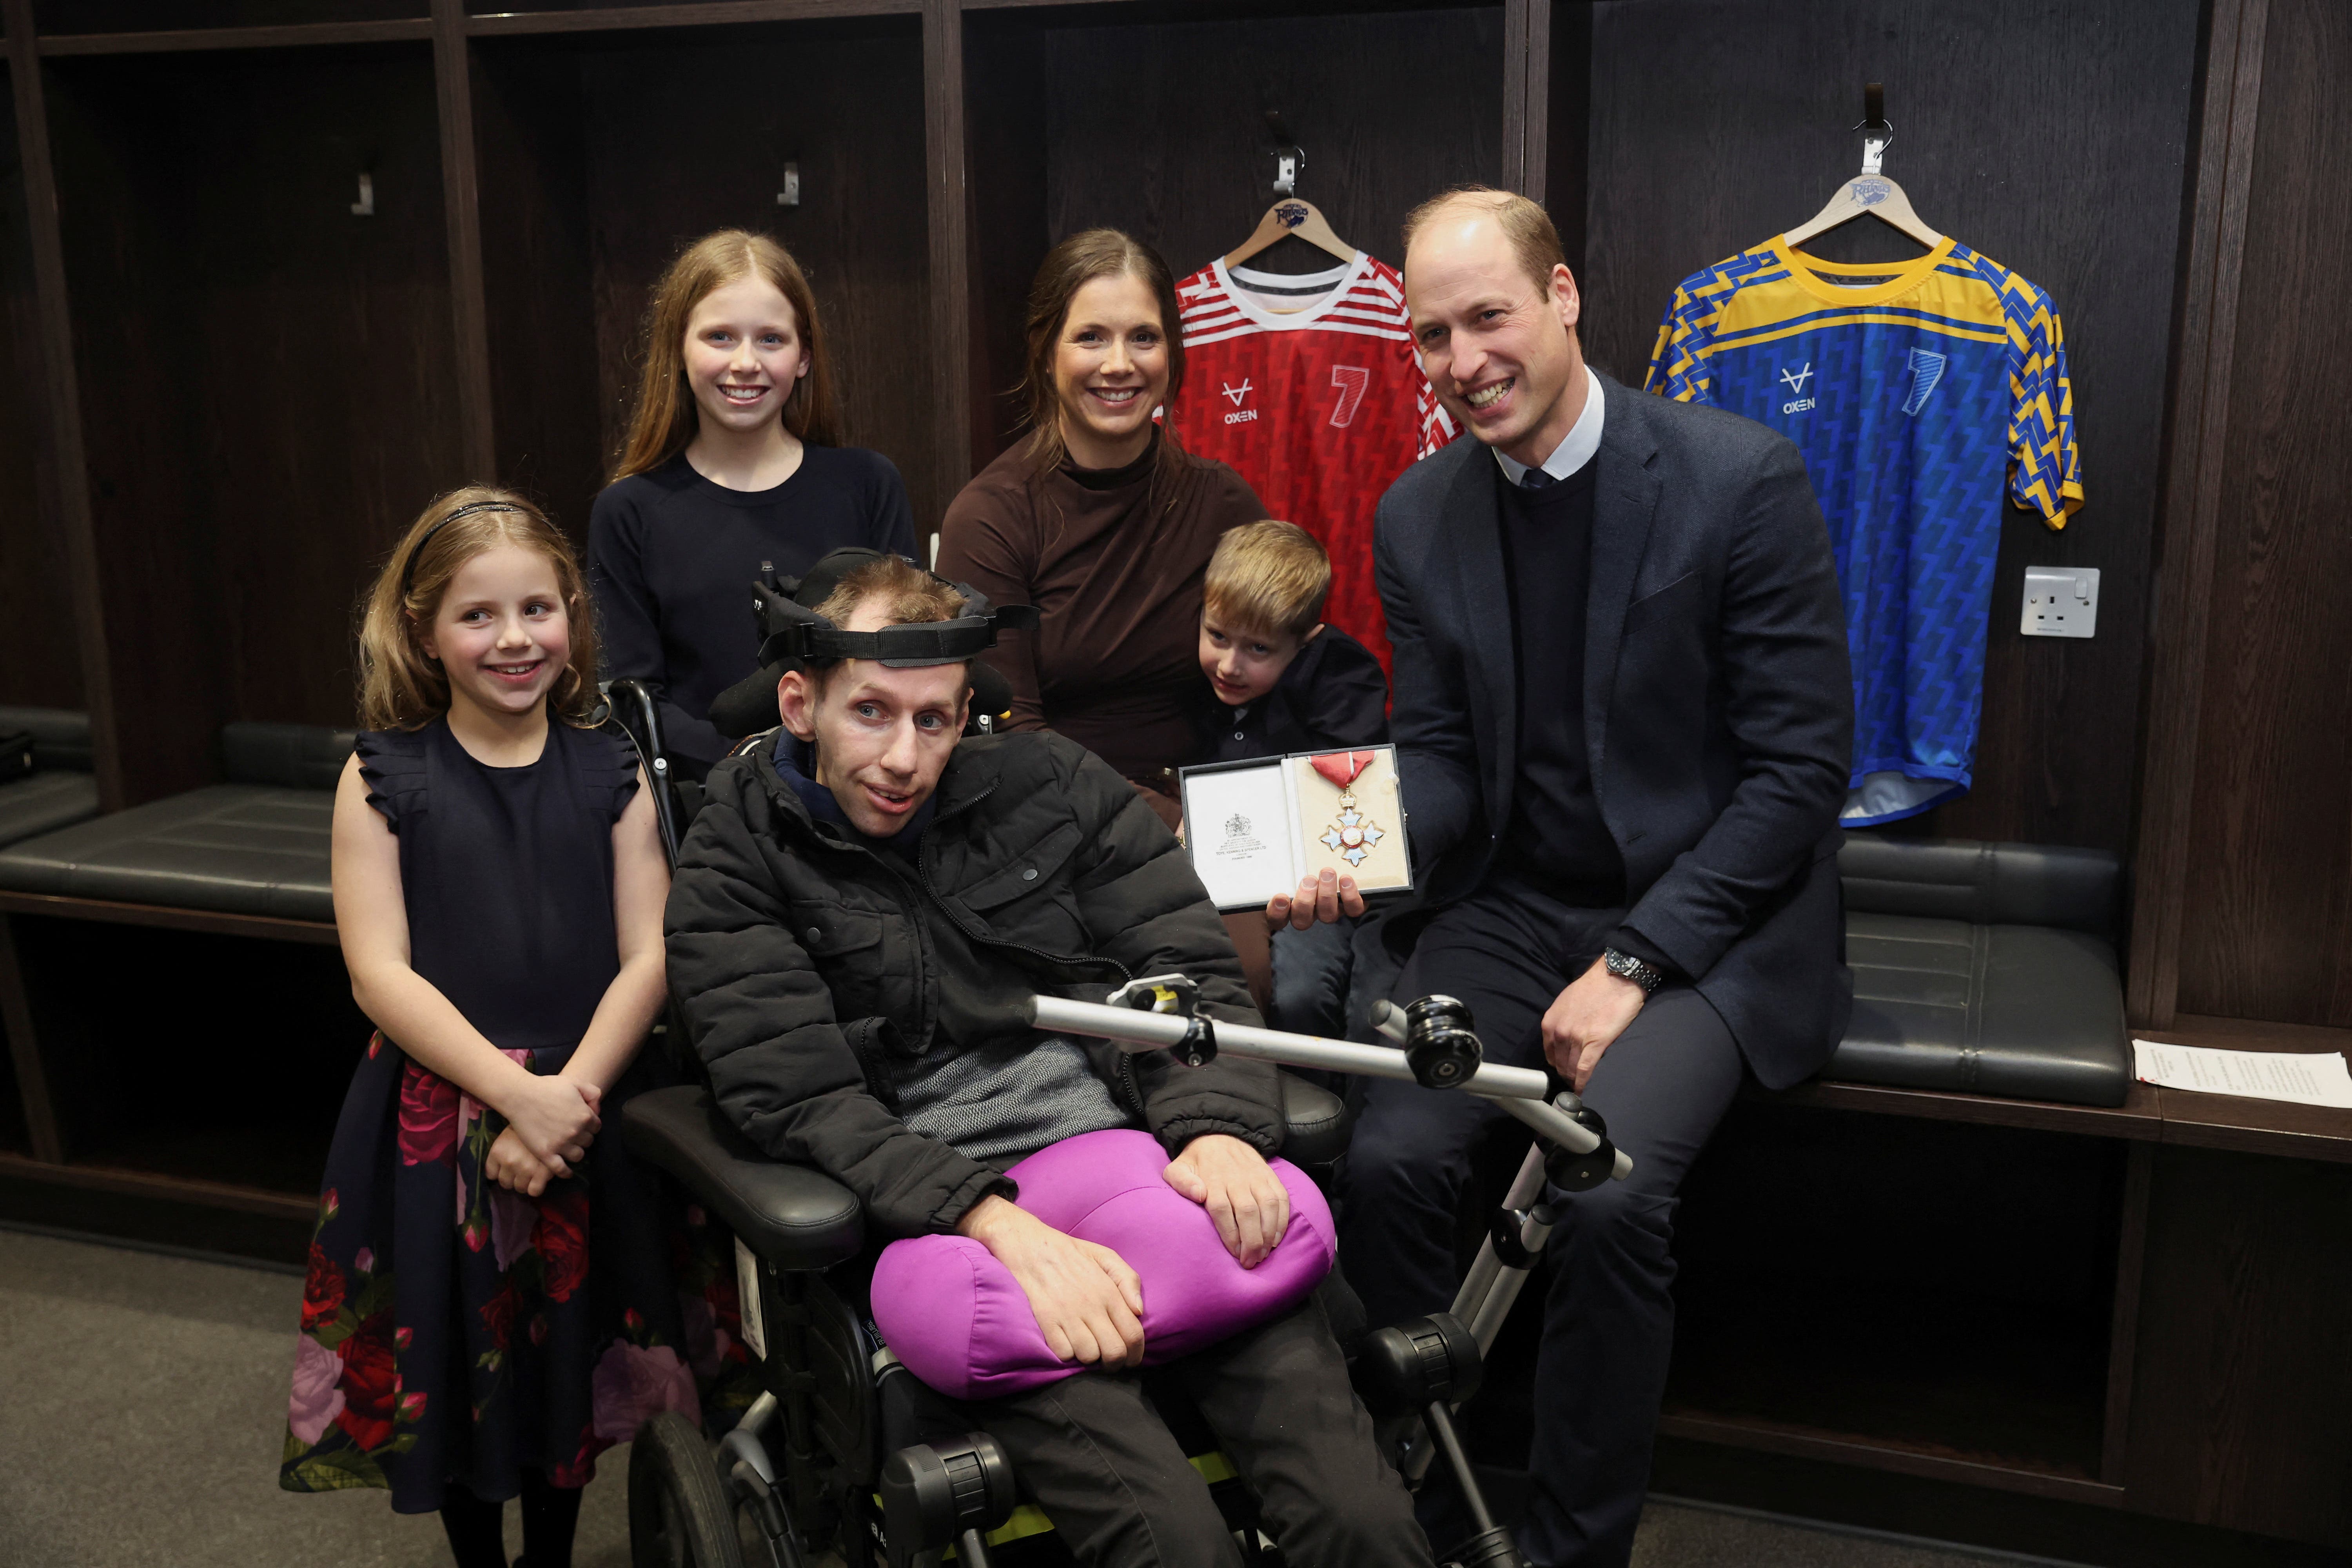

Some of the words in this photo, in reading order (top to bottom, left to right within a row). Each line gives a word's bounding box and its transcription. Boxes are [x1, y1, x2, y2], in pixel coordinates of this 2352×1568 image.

[1329, 365, 1370, 428] 7
[1902, 347, 1947, 417] 7
[1225, 409, 1258, 424] OXEN
[1783, 397, 1815, 414] OXEN
